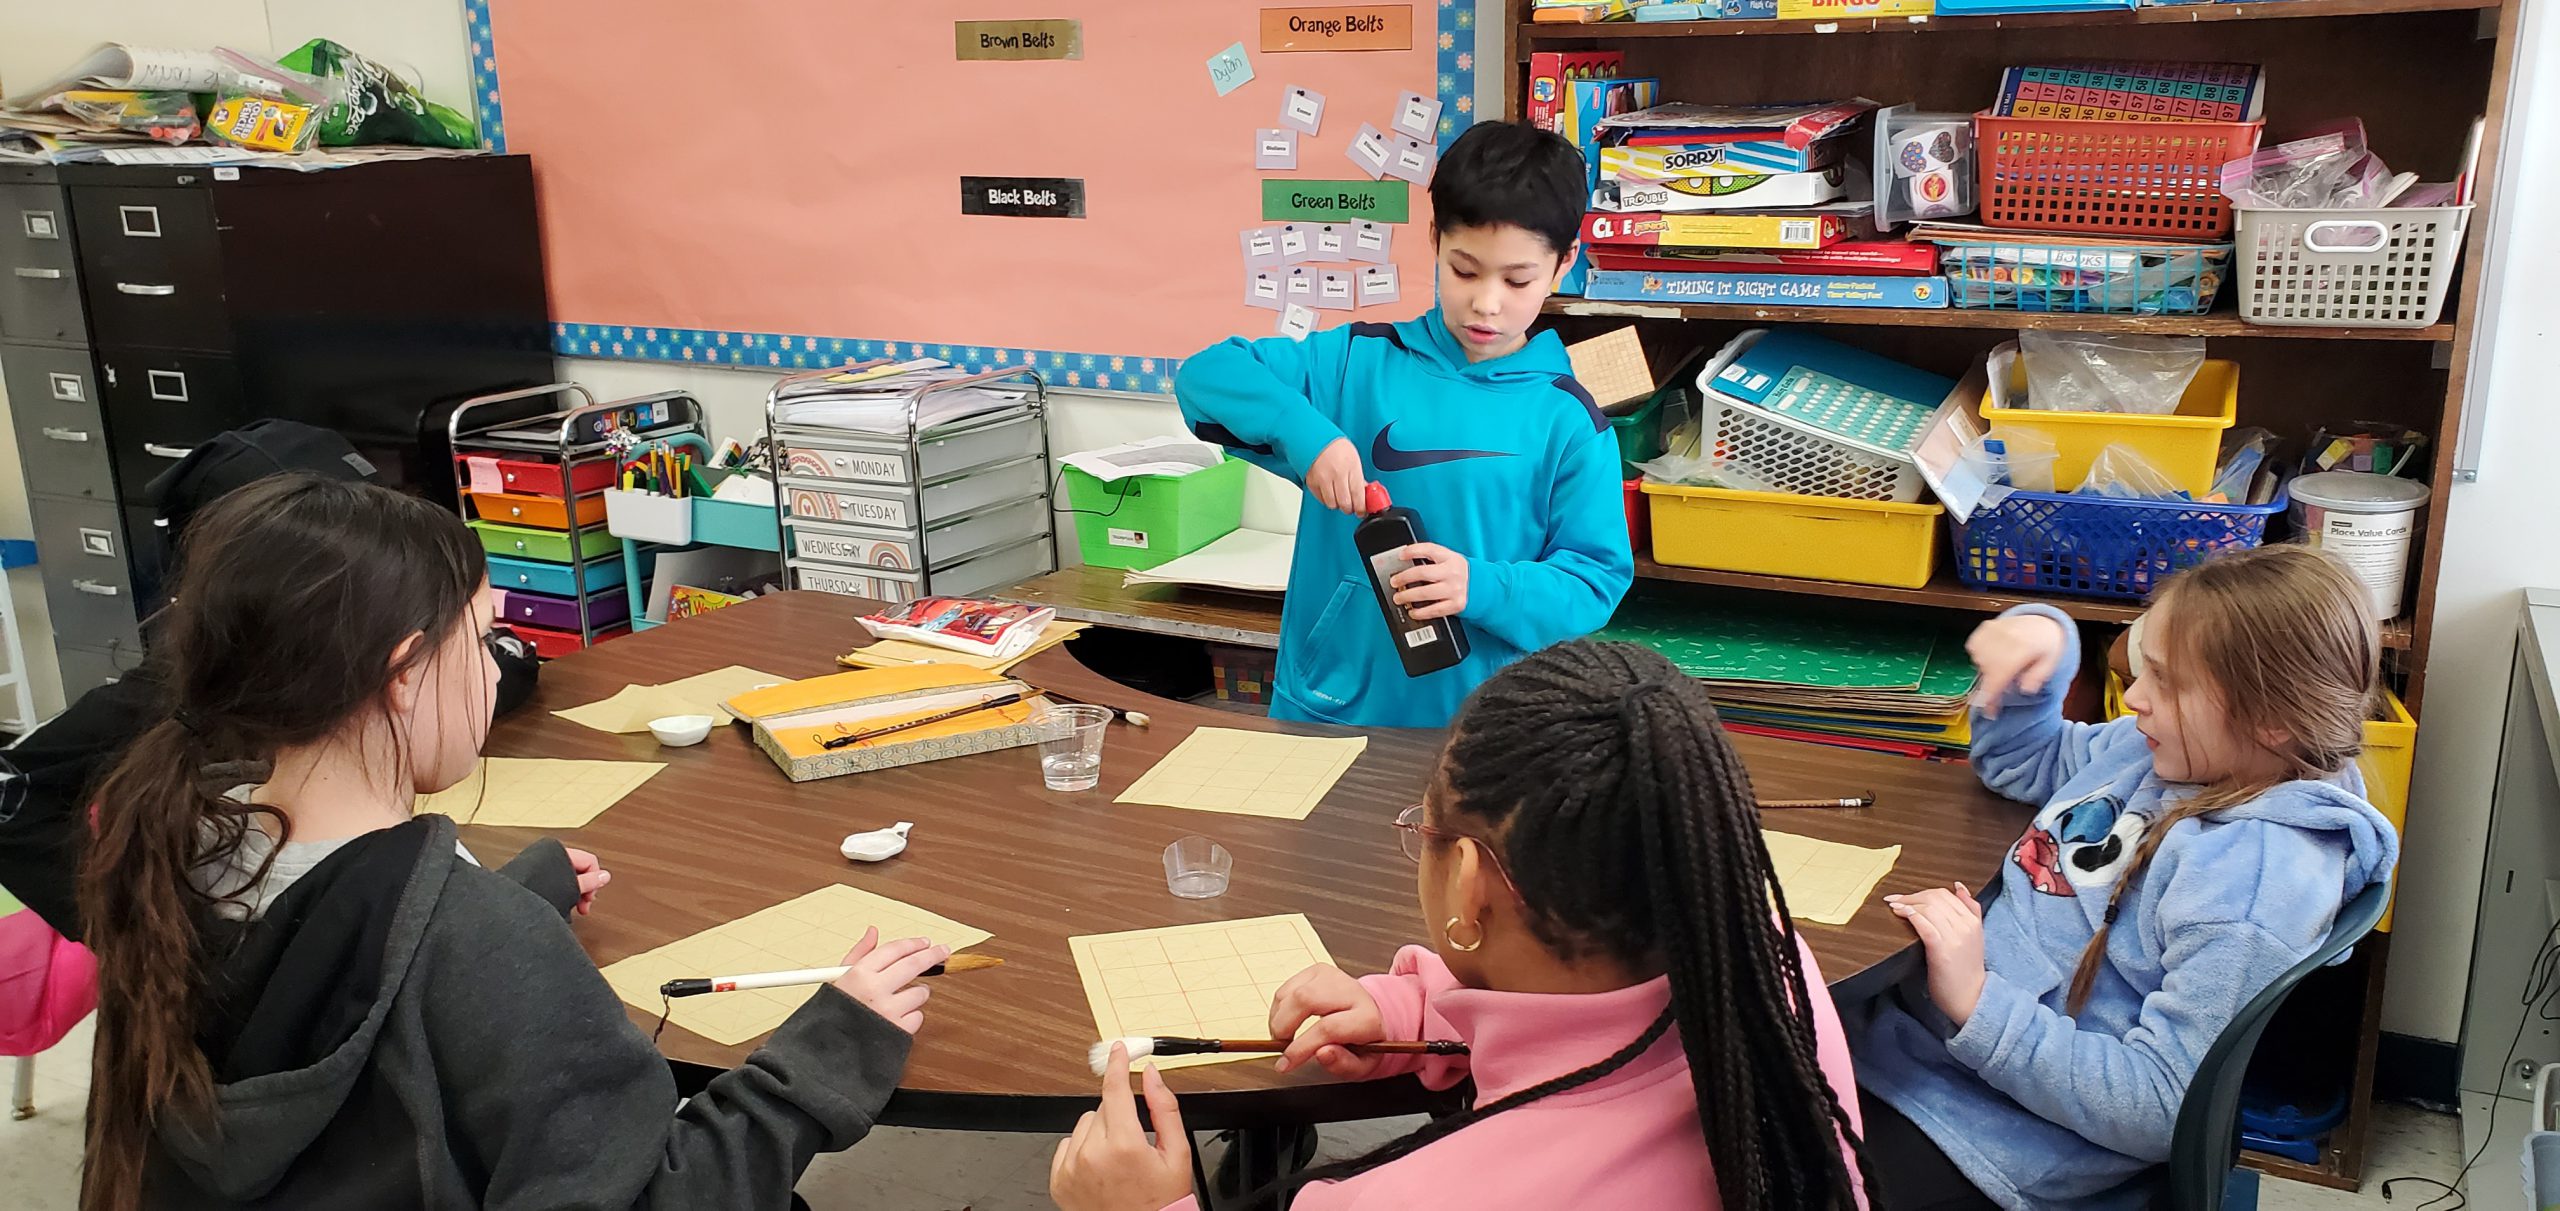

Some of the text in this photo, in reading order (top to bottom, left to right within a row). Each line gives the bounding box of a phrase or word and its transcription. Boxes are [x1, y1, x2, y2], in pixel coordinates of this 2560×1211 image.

[1289, 15, 1384, 37] Orange Belts
[980, 32, 1055, 49] Brown Belts
[1213, 57, 1243, 82] Dylan
[2028, 69, 2239, 101] 8 18 28 38 48 58 68 78 88 98
[2044, 87, 2055, 97] 17
[2064, 88, 2076, 101] 27
[2087, 91, 2099, 103] 37
[2110, 93, 2121, 106] 47
[2131, 96, 2144, 109] 57
[2154, 98, 2166, 111] 67
[2176, 101, 2189, 113] 77
[2200, 103, 2212, 115] 87
[2222, 106, 2235, 118] 97
[230, 102, 252, 139] PENCILS
[241, 101, 263, 139] COLORED
[2039, 106, 2051, 115] 16
[2060, 106, 2072, 119] 26
[1665, 148, 1725, 171] SORRY!
[988, 188, 1057, 207] Black Belts
[1291, 192, 1376, 211] Green Belts
[1623, 191, 1668, 206] TROUBLE
[1592, 217, 1633, 239] CLUE
[1667, 280, 1821, 298] TIMING IT RIGHT GAME
[1917, 287, 1928, 297] 7+
[852, 460, 895, 477] MONDAY
[851, 502, 897, 521] TUESDAY
[2331, 527, 2407, 537] Place Value Cards
